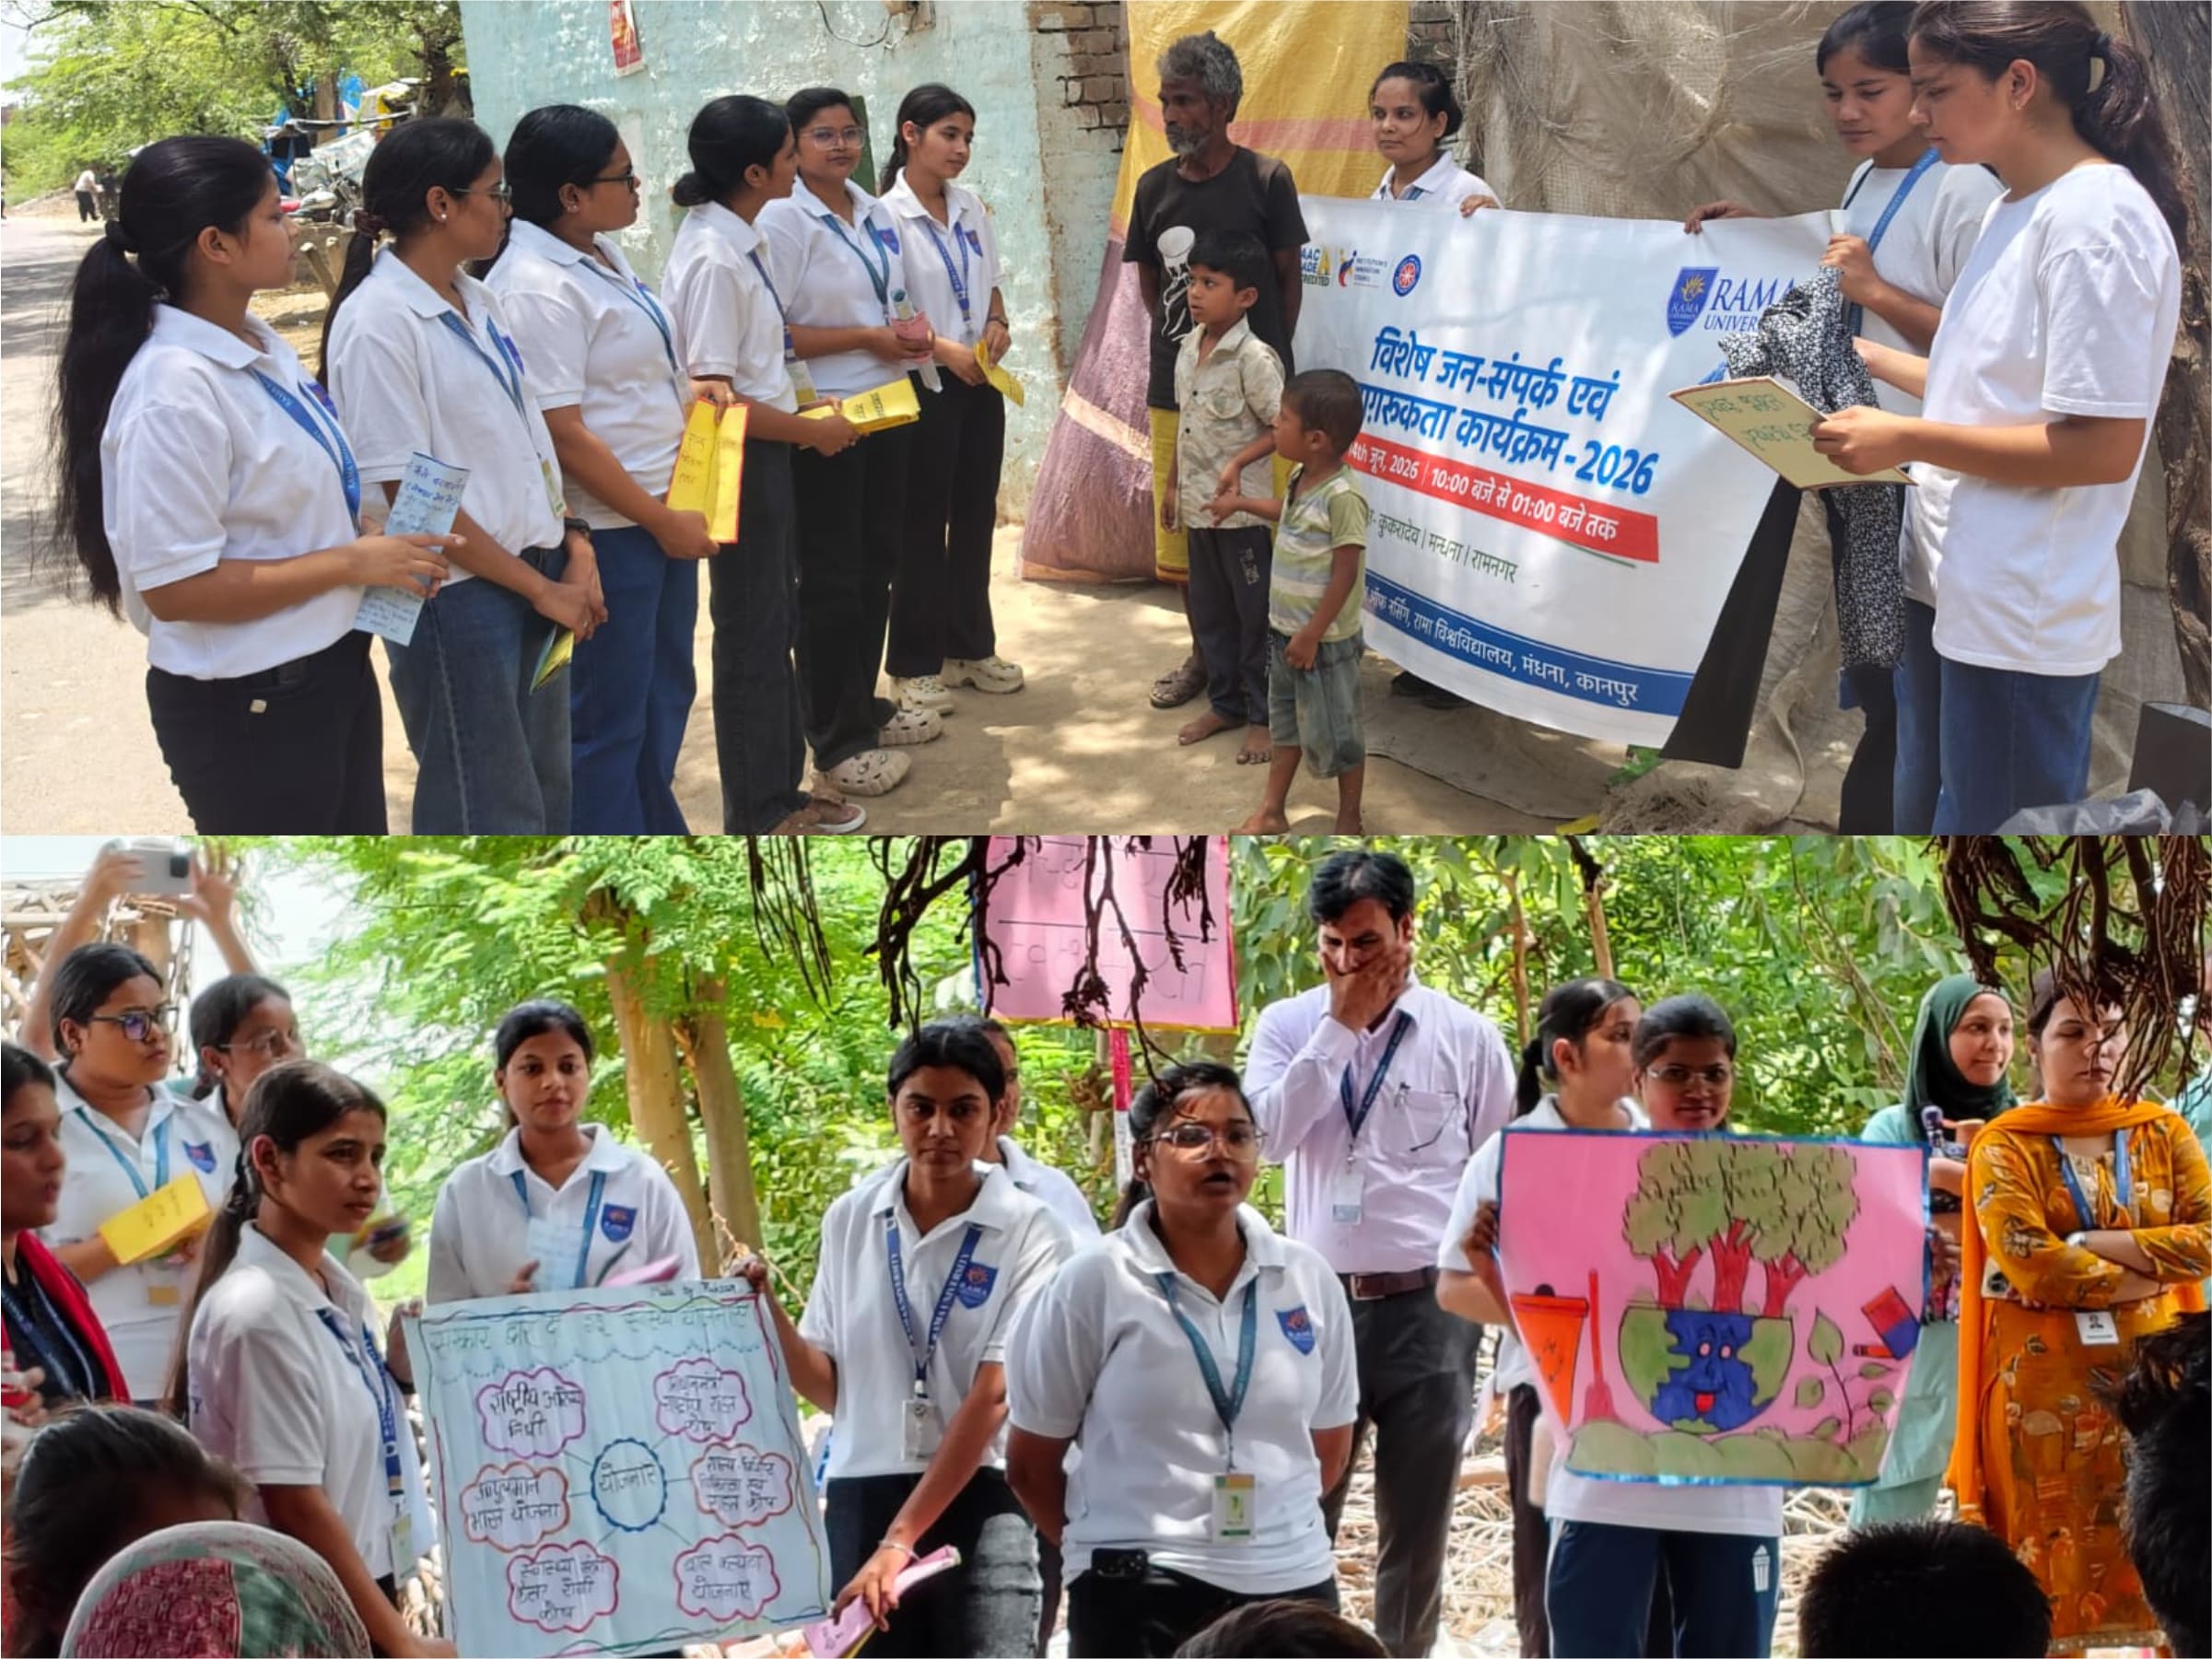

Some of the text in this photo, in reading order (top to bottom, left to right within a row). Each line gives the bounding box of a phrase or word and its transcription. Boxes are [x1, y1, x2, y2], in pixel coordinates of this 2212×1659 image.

[1301, 247, 1321, 262] AAC
[1704, 313, 1758, 332] UNIVER
[1371, 326, 1437, 380] विशेष
[1567, 370, 1620, 422] एवं
[1389, 454, 1420, 479] 2026
[1431, 468, 1469, 496] 10:00
[1471, 475, 1495, 504] बजे
[1495, 482, 1512, 510] से
[1512, 492, 1556, 523] 01:00
[1557, 503, 1586, 533] बजे
[1585, 516, 1619, 542] तक
[1471, 549, 1519, 584] रामनगर
[1574, 671, 1639, 707] कानपुर
